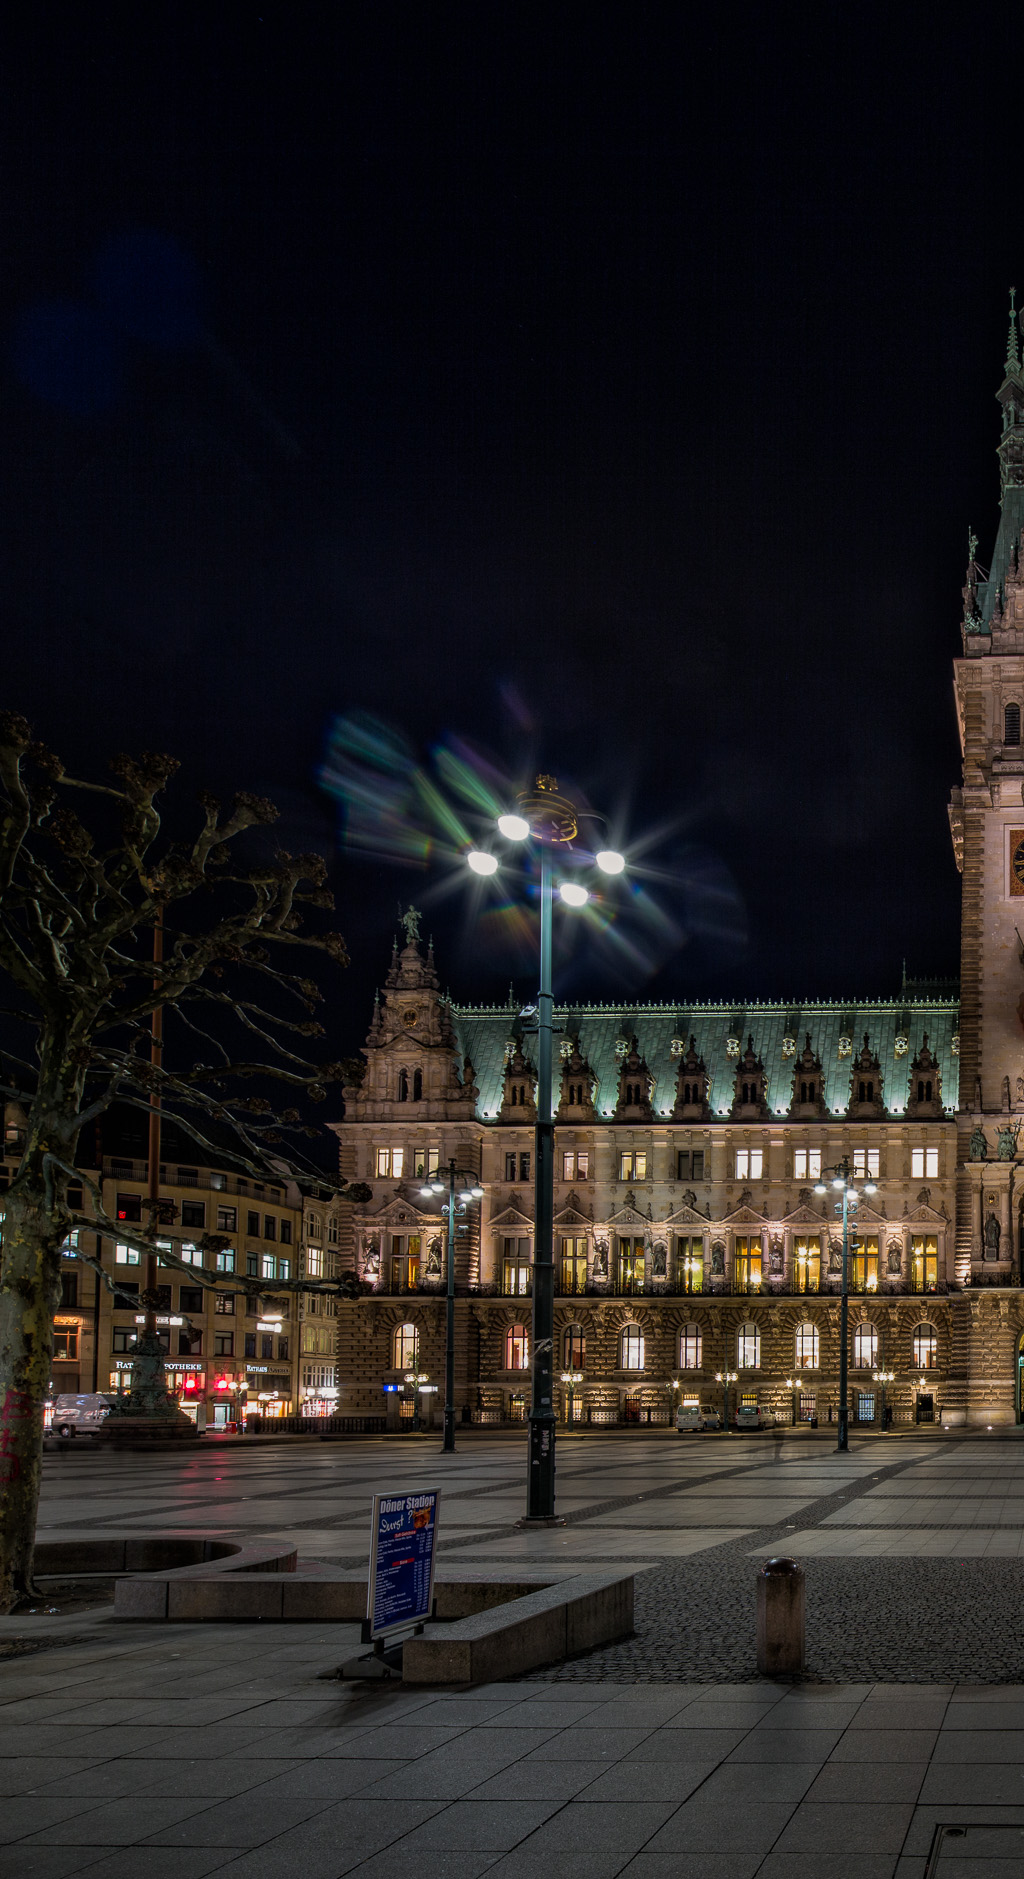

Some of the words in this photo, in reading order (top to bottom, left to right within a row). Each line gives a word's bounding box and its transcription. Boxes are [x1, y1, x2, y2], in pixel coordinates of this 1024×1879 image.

[164, 1363, 202, 1371] POTHEKE
[380, 1499, 406, 1514] Döner
[406, 1495, 435, 1510] Station
